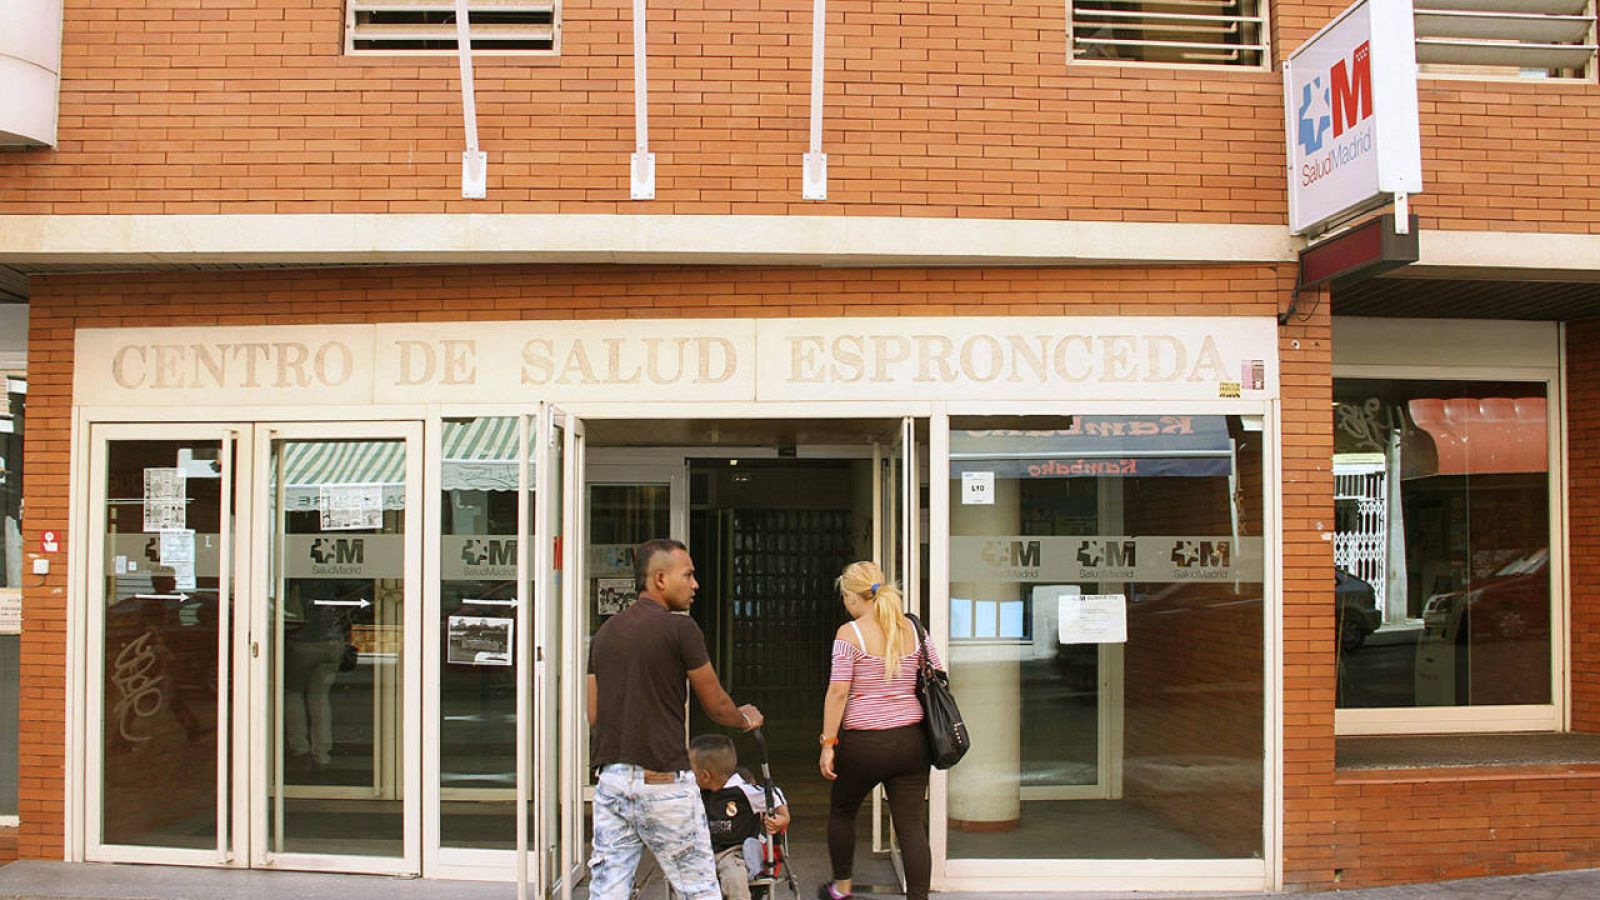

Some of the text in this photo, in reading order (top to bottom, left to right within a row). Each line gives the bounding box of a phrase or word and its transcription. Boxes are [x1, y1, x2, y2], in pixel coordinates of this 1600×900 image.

[112, 341, 354, 389] CENTRO
[394, 339, 477, 386] DE
[521, 336, 737, 385] SALUD
[785, 334, 1231, 383] ESPRONCEDA
